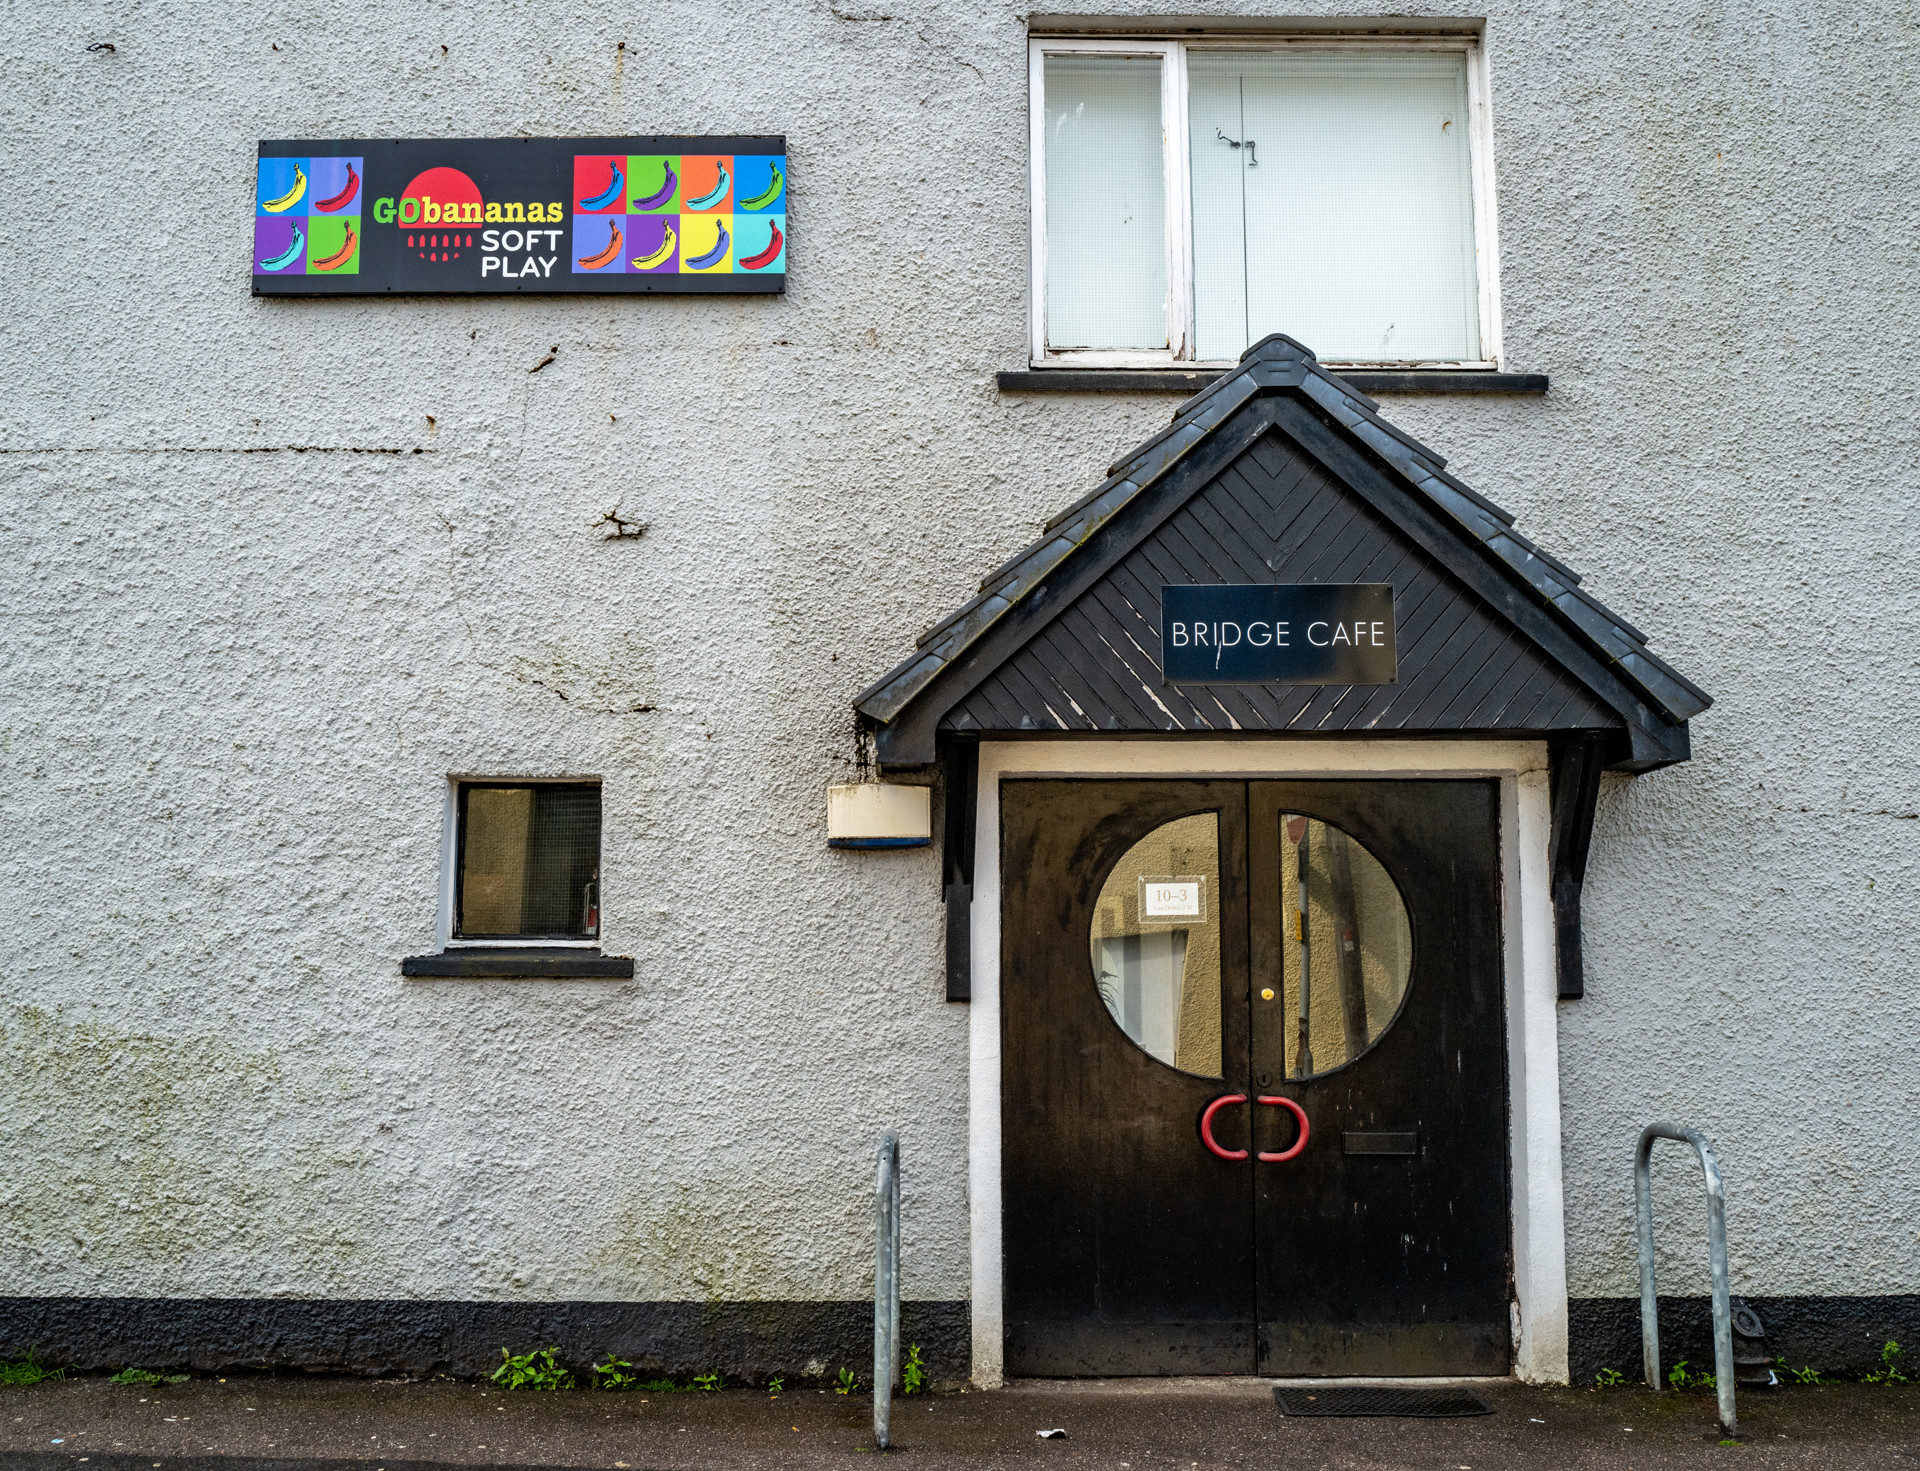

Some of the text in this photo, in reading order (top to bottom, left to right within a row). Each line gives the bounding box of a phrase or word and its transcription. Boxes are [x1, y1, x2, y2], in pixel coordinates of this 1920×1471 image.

[481, 230, 564, 252] SOFT
[482, 256, 559, 278] PLAY
[1172, 622, 1385, 646] BRIDGE CAFE
